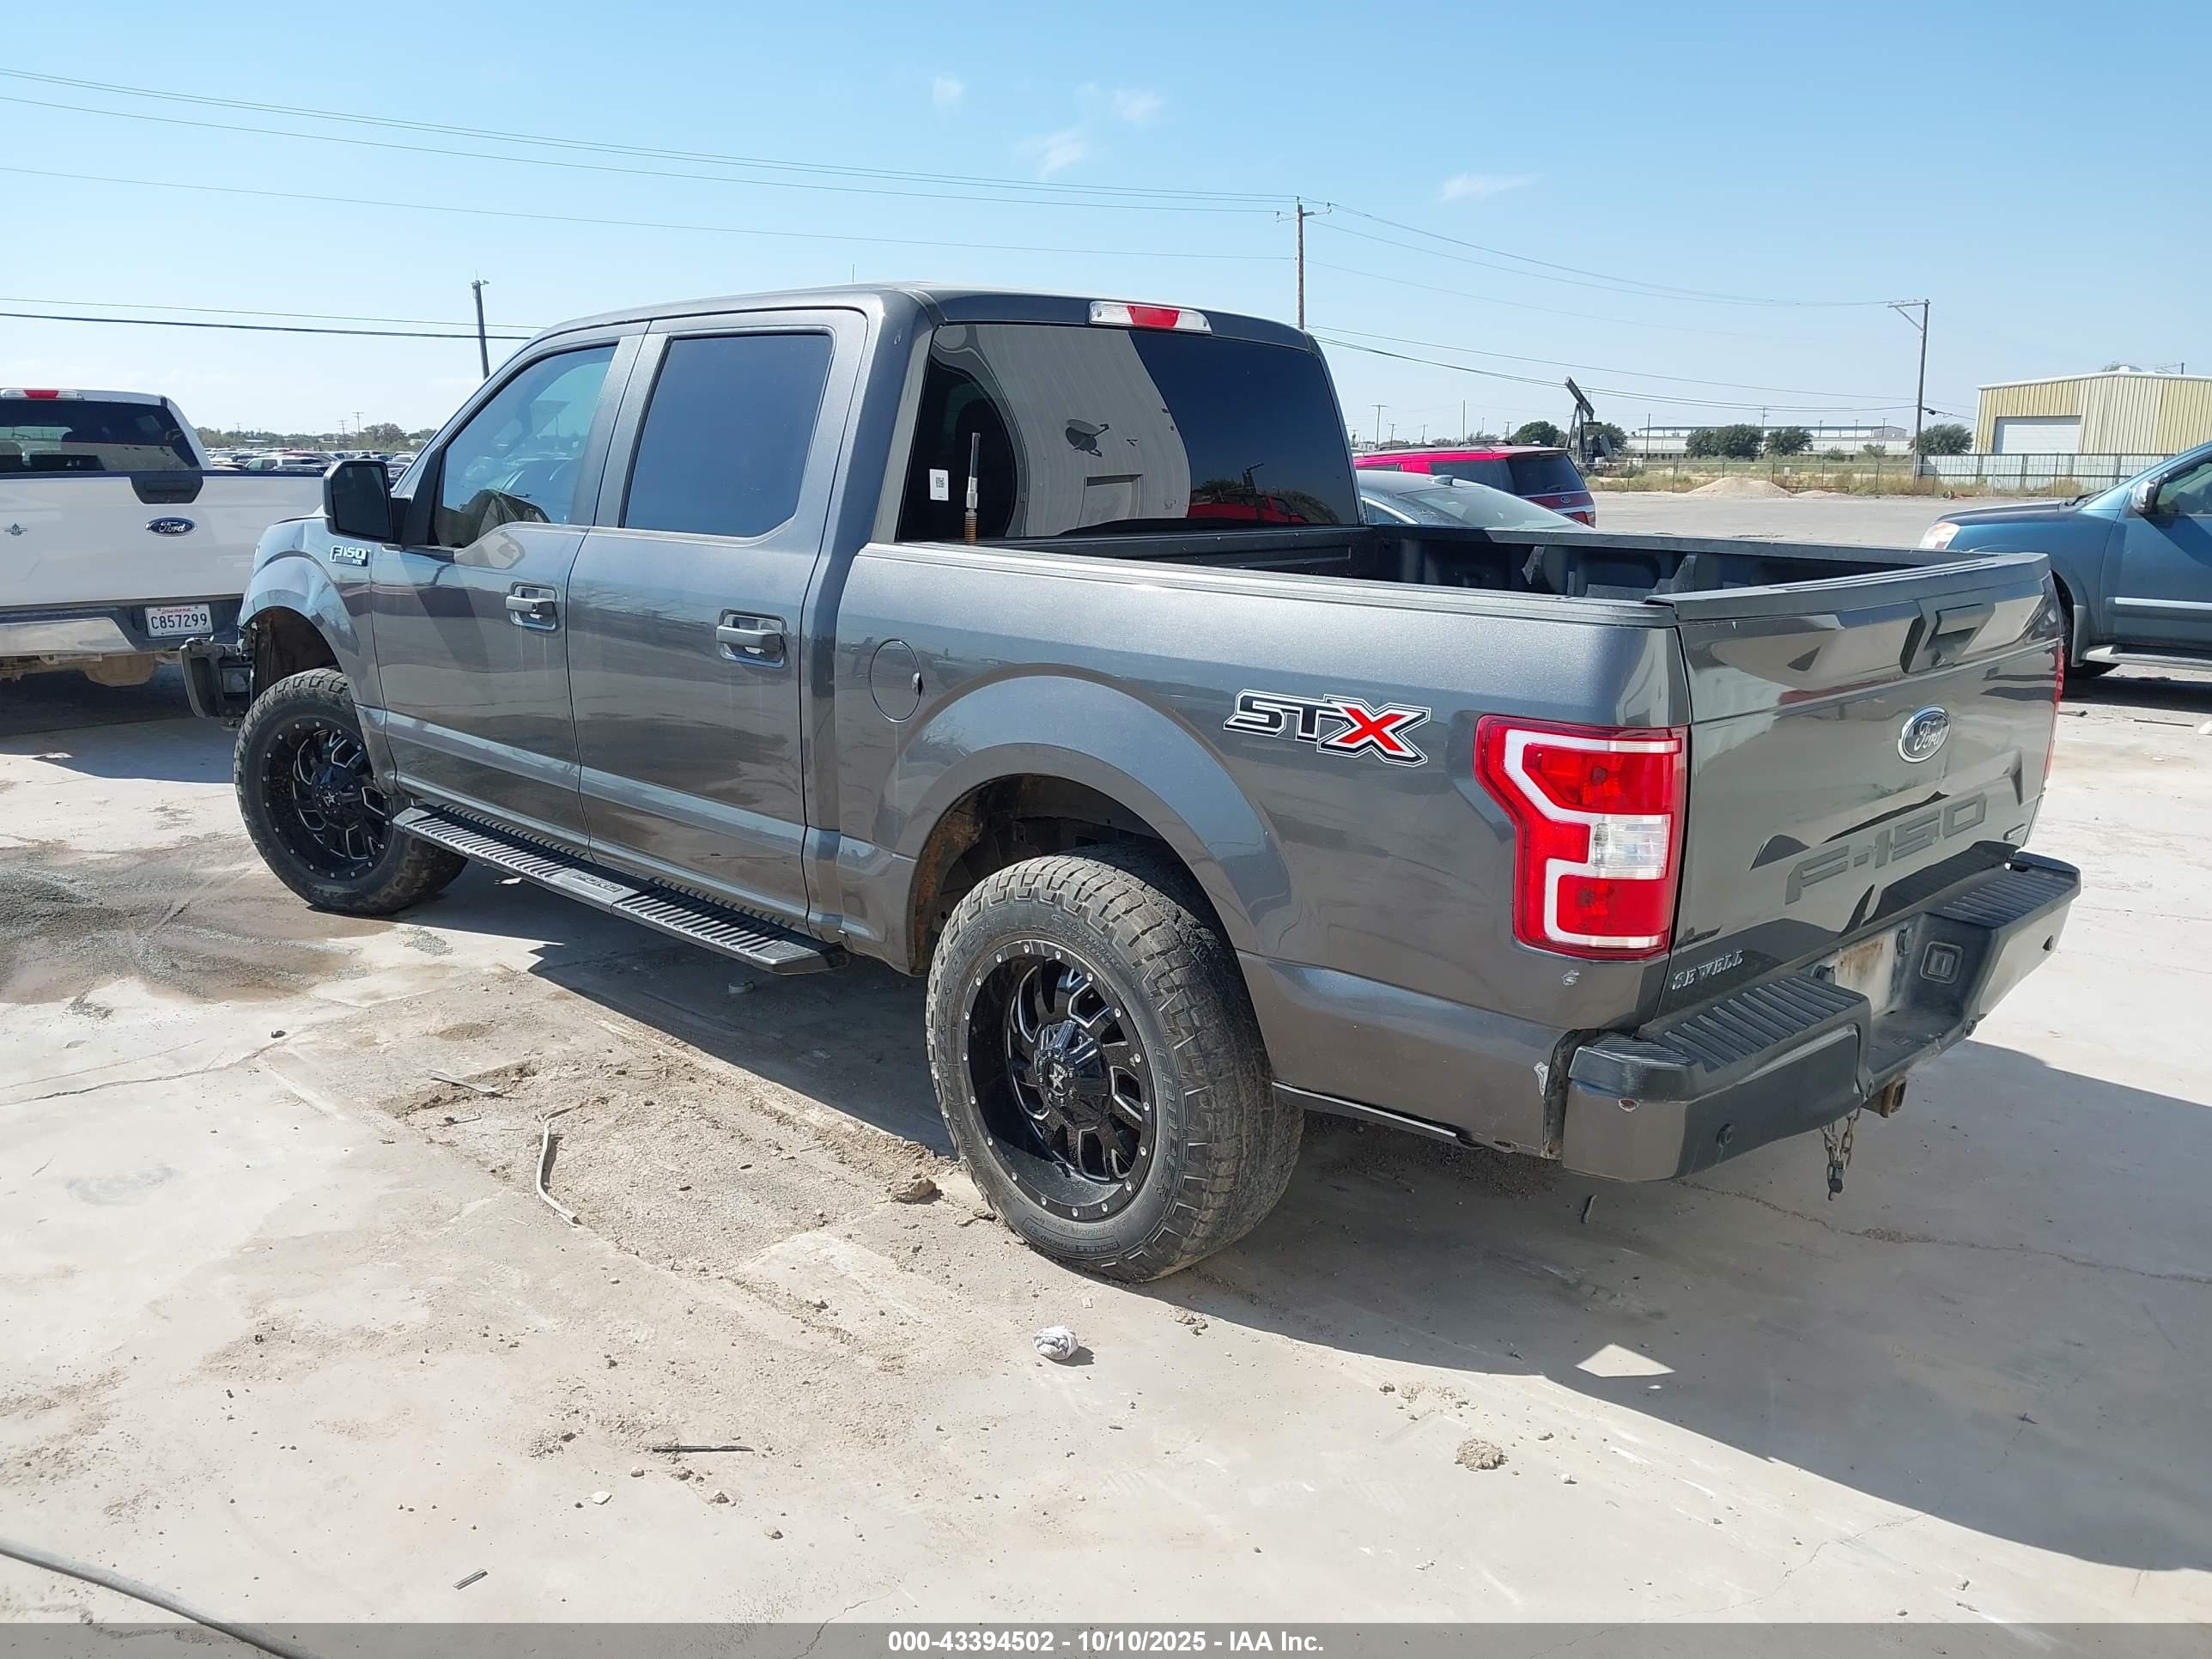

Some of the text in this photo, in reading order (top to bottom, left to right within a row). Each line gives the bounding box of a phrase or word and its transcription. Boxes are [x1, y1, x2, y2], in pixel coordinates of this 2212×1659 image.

[150, 613, 208, 629] C857299
[1224, 689, 1432, 768] STX
[1785, 795, 1987, 906] F-150
[1671, 949, 1745, 990] SEWELL
[1154, 1047, 1179, 1203] COOPER
